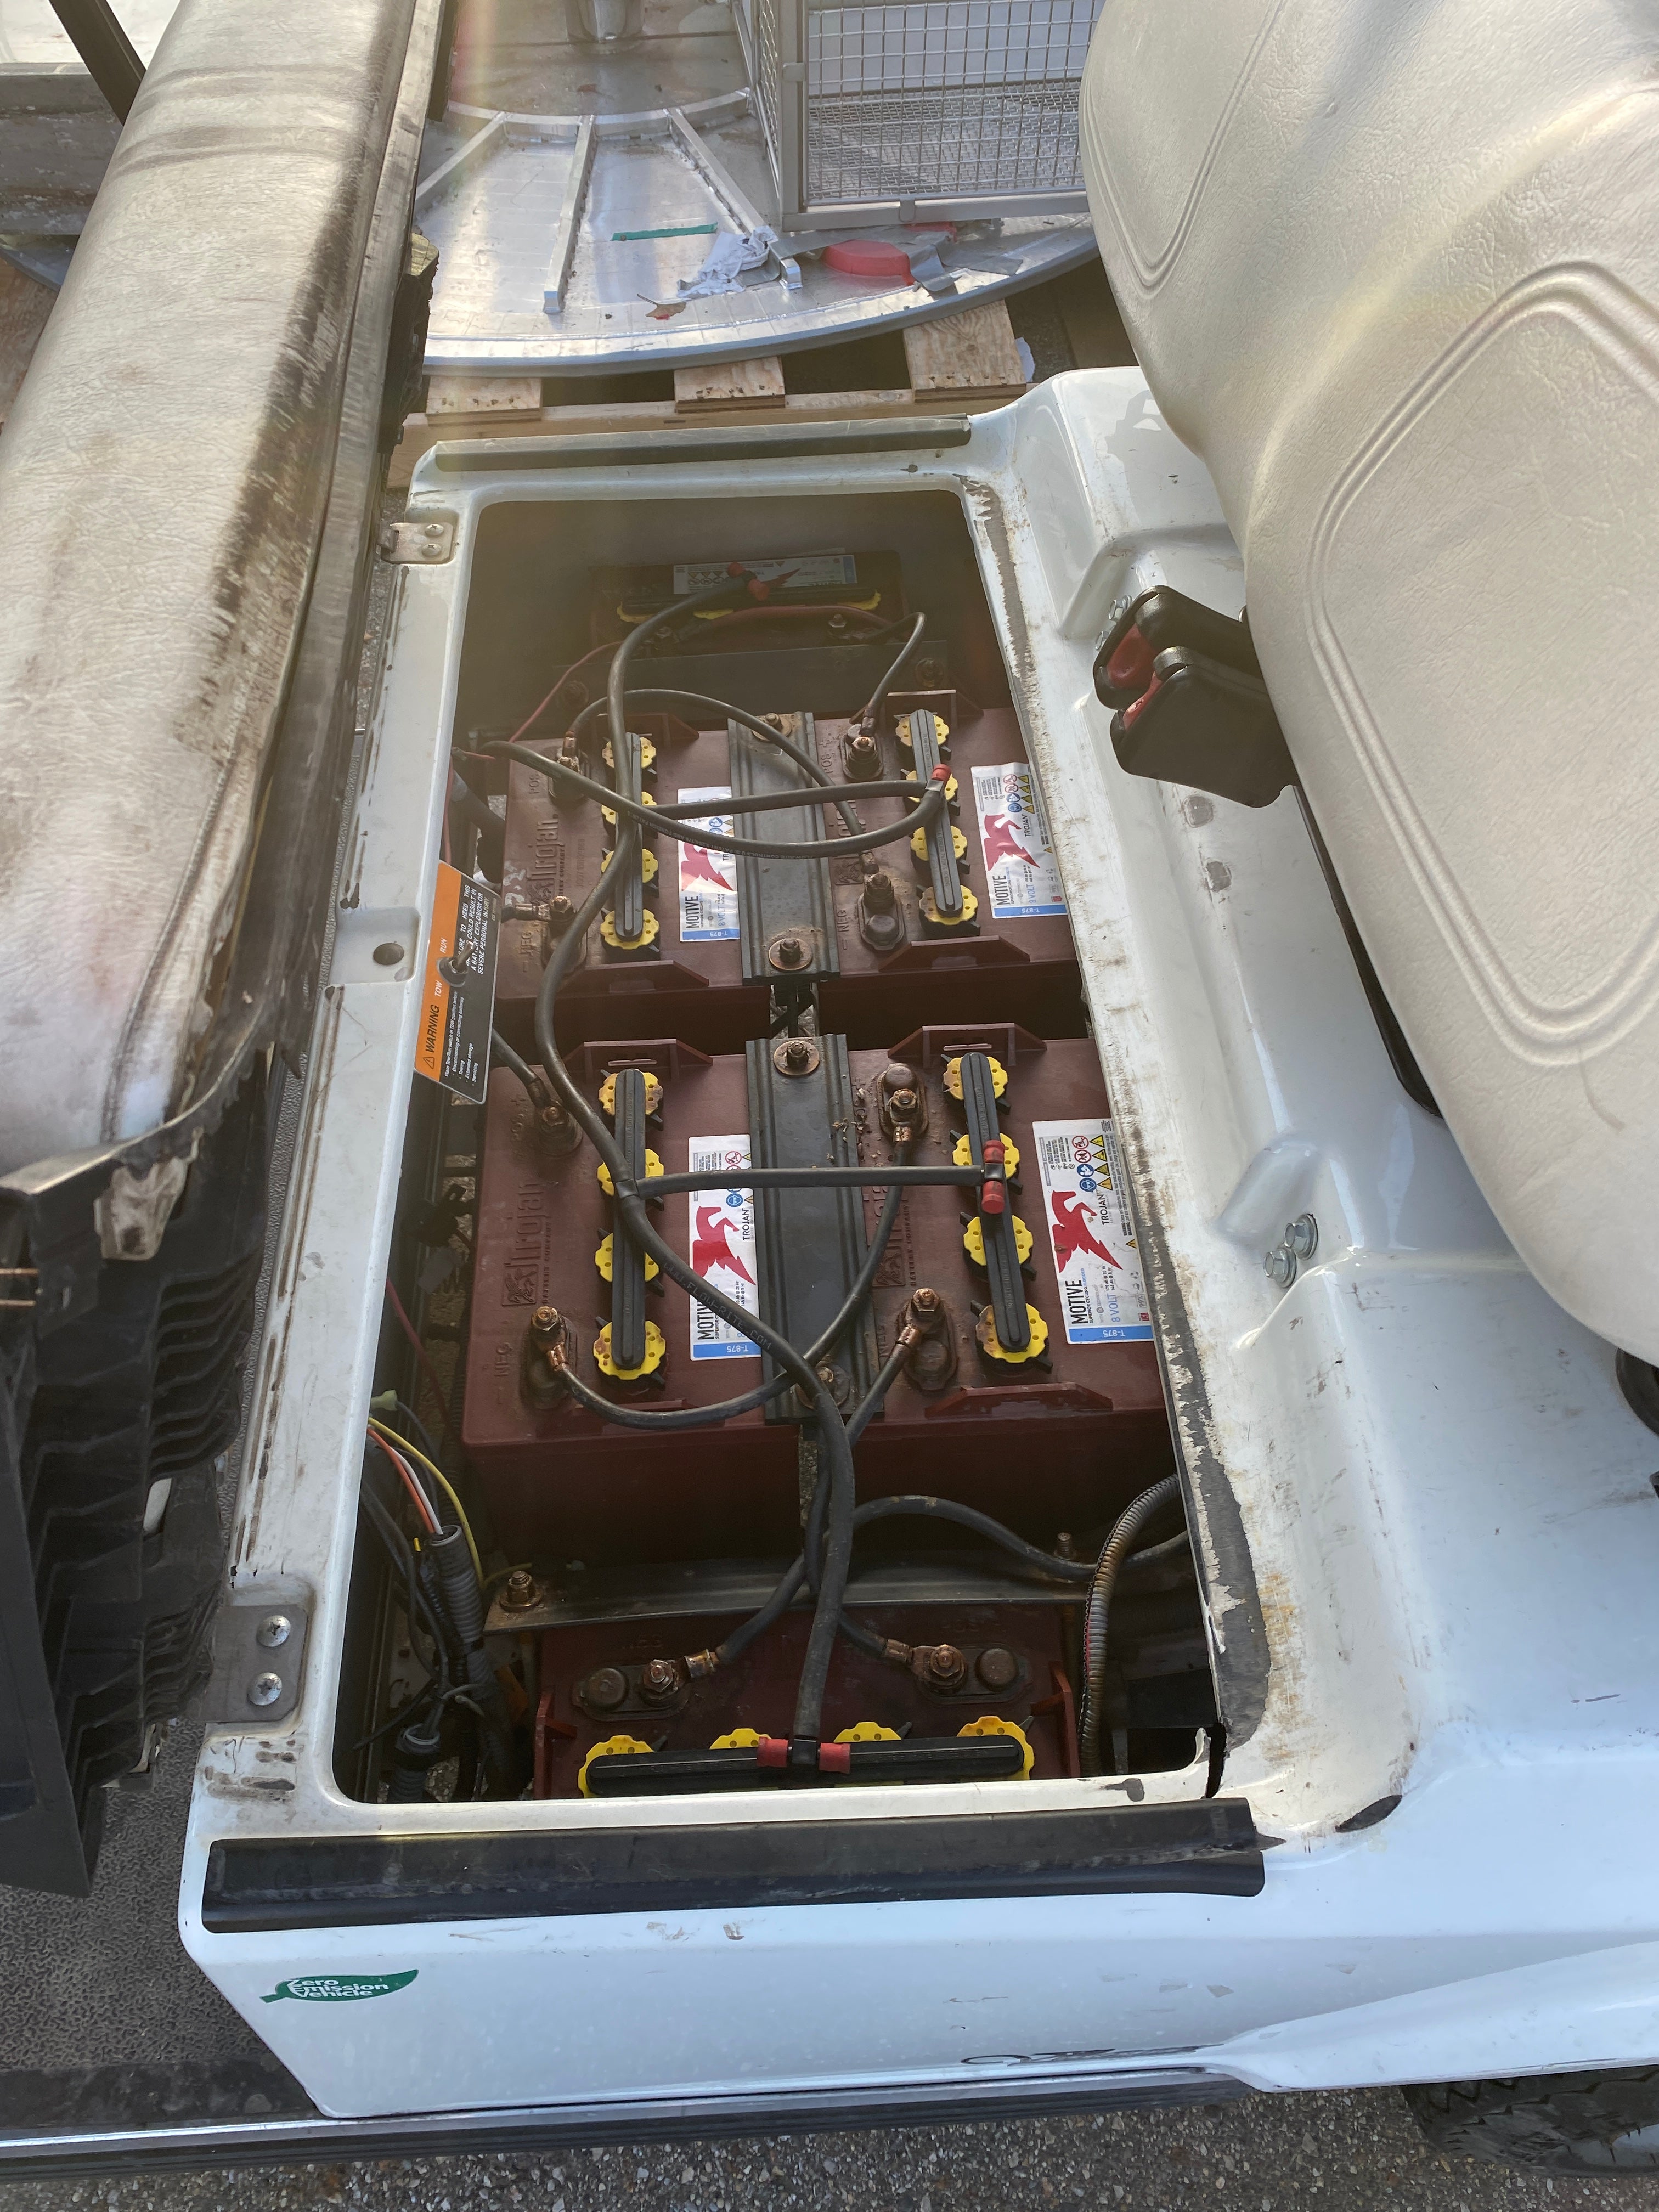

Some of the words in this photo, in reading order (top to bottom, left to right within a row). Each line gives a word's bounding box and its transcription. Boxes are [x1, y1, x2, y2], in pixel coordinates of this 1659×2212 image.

[1023, 815, 1031, 837] TROJAN
[477, 892, 484, 902] OR
[992, 875, 1011, 905] MOTIVE
[1026, 884, 1036, 899] VOLT
[474, 902, 482, 936] EXPLOSION
[685, 896, 700, 928] MOTIVE
[718, 906, 726, 922] VOLT
[460, 924, 466, 933] TO
[425, 1004, 439, 1053] WARNING
[1097, 1194, 1110, 1226] TROJAN
[742, 1209, 751, 1241] TROJAN
[1065, 1280, 1088, 1324] MOTIVE
[1107, 1293, 1119, 1316] VOLT
[697, 1300, 714, 1340] MOTIV
[1102, 1329, 1126, 1338] T-875
[726, 1345, 749, 1353] T-875
[290, 1984, 390, 1993] Emission
[295, 1989, 373, 1997] Vehicle
